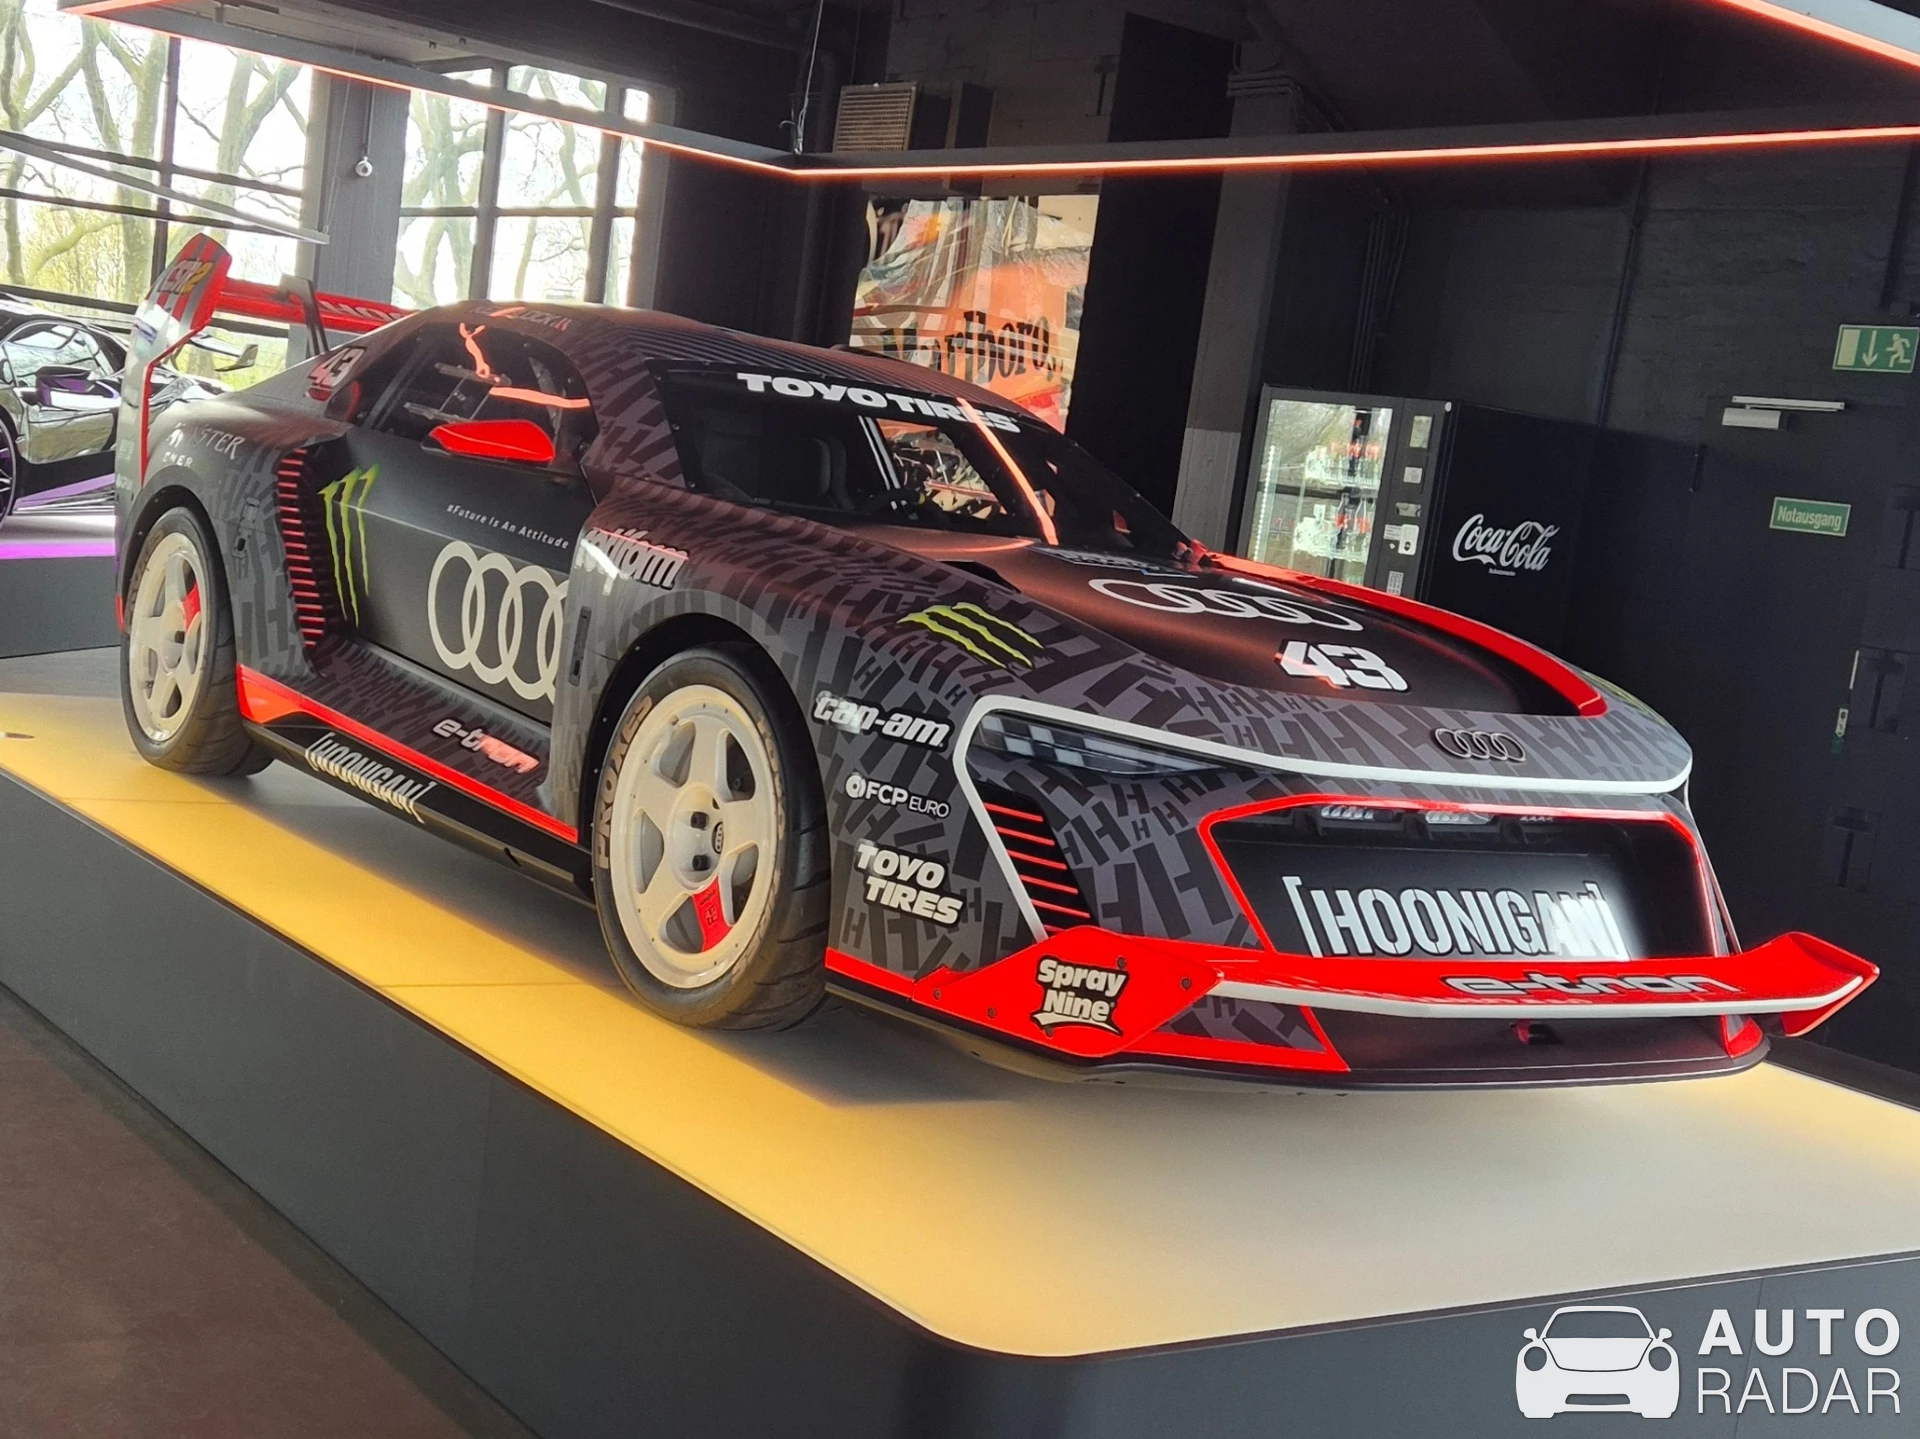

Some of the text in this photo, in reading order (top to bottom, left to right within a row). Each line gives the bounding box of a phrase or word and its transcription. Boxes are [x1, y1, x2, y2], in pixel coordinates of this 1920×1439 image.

[501, 520, 517, 533] An
[518, 526, 570, 550] Attitude
[1777, 505, 1842, 532] Notausgang
[1452, 513, 1560, 571] Coca-Cola
[1280, 640, 1409, 691] 43
[813, 697, 950, 747] can-am
[595, 695, 652, 870] PROXES
[866, 780, 950, 818] FCP EURO
[857, 843, 946, 890] TOYO
[866, 875, 964, 924] TIRES
[1037, 958, 1127, 998] Spray
[1445, 972, 1743, 995] e-tron
[1043, 988, 1111, 1022] Nine
